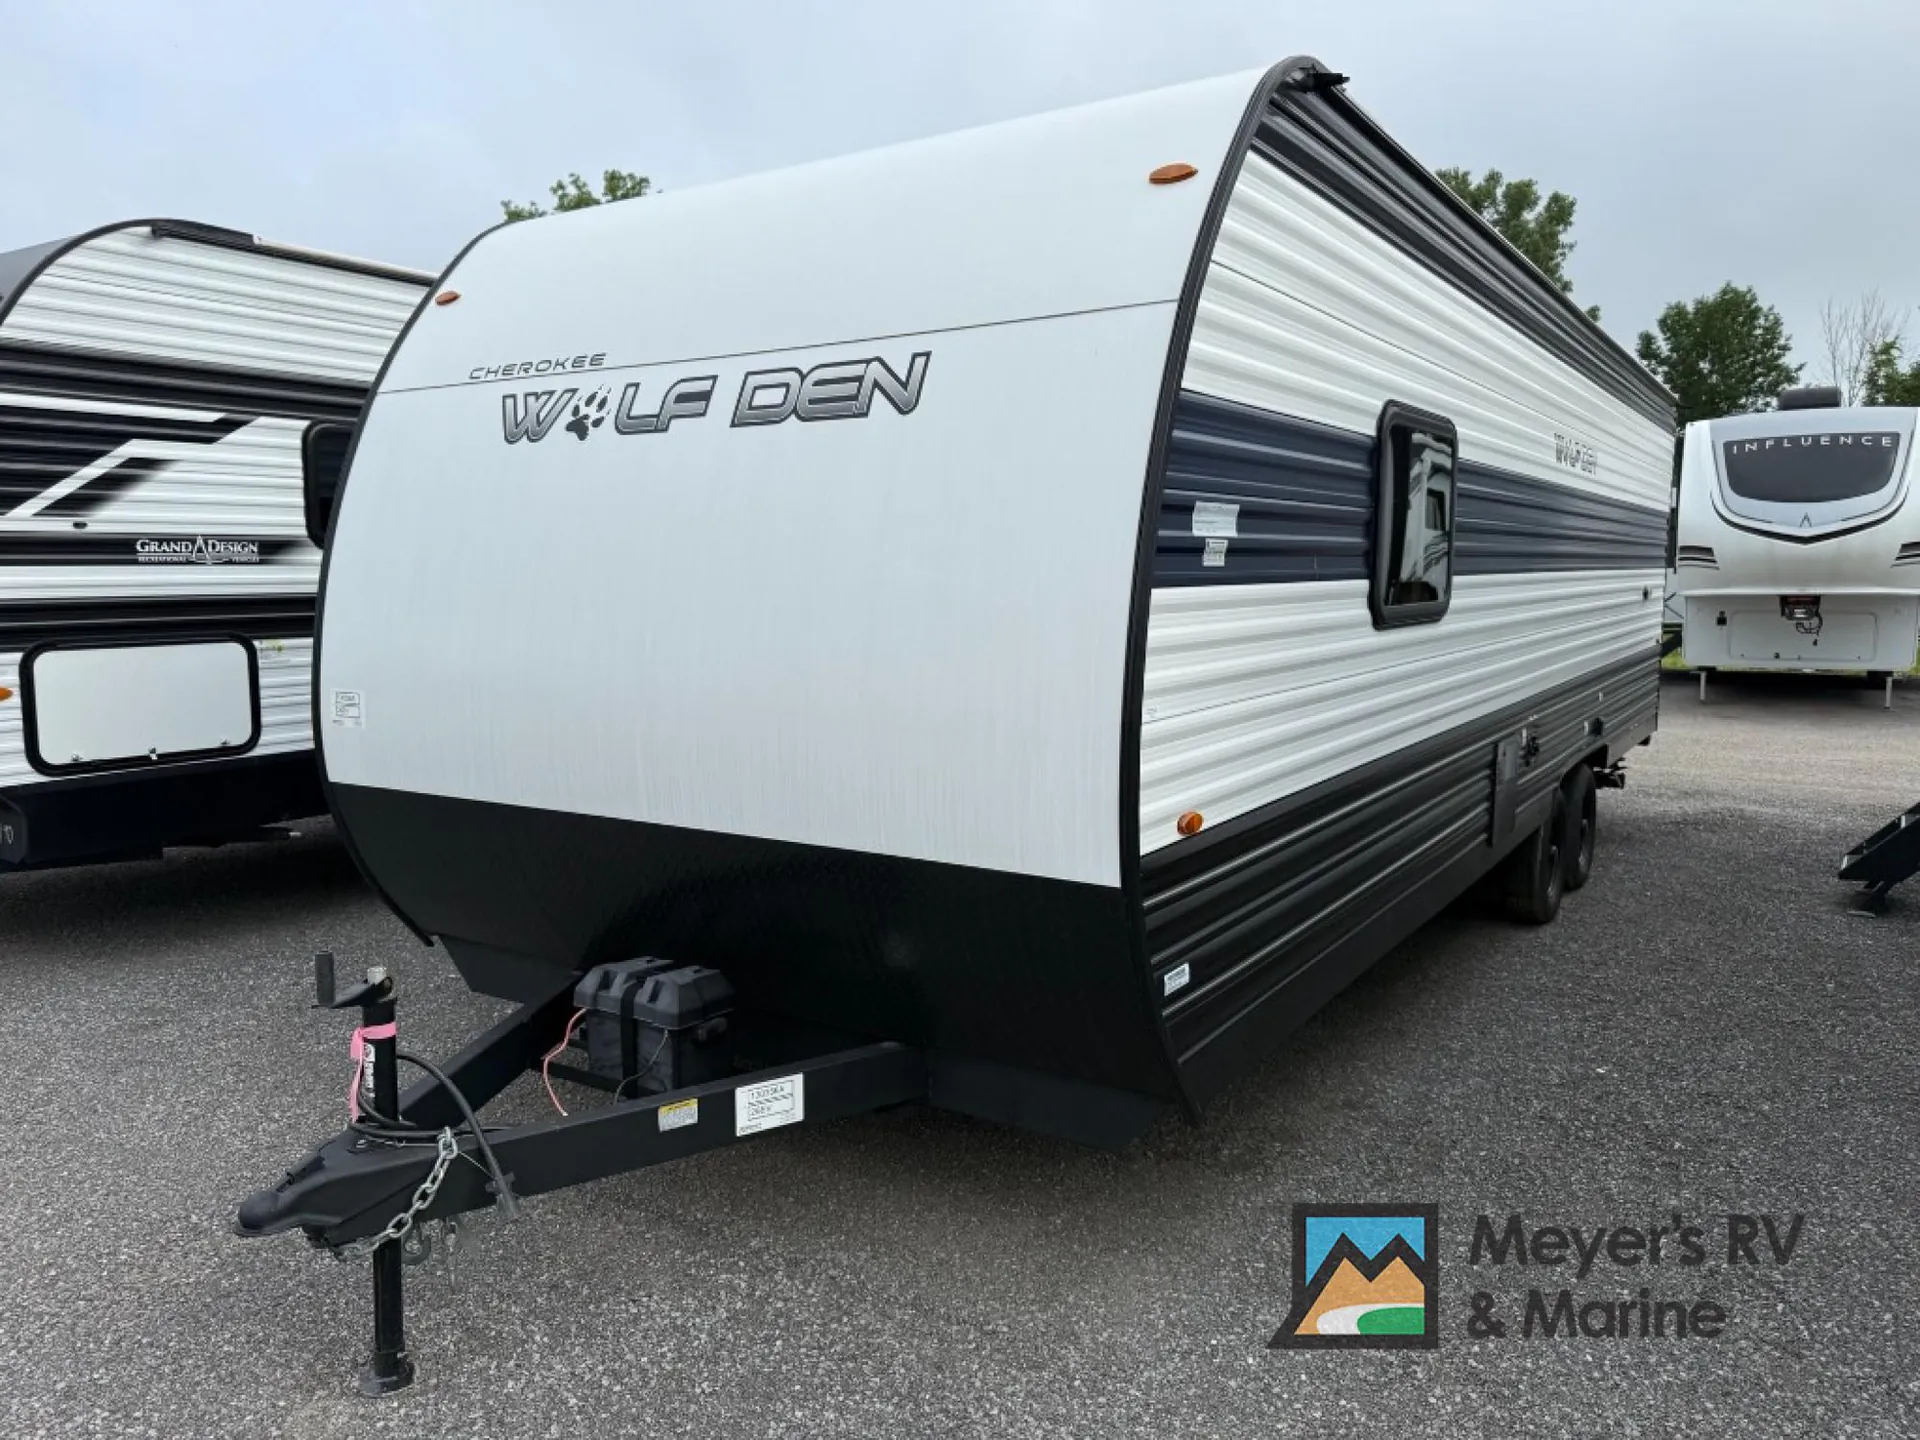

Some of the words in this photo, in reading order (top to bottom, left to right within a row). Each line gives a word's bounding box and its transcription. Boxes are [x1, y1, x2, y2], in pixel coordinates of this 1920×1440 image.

[468, 352, 606, 380] CHEROKEE
[729, 350, 932, 428] DEN
[1732, 435, 1893, 455] INFLUENCE
[135, 539, 192, 553] GRAND
[207, 539, 259, 553] DESIGN
